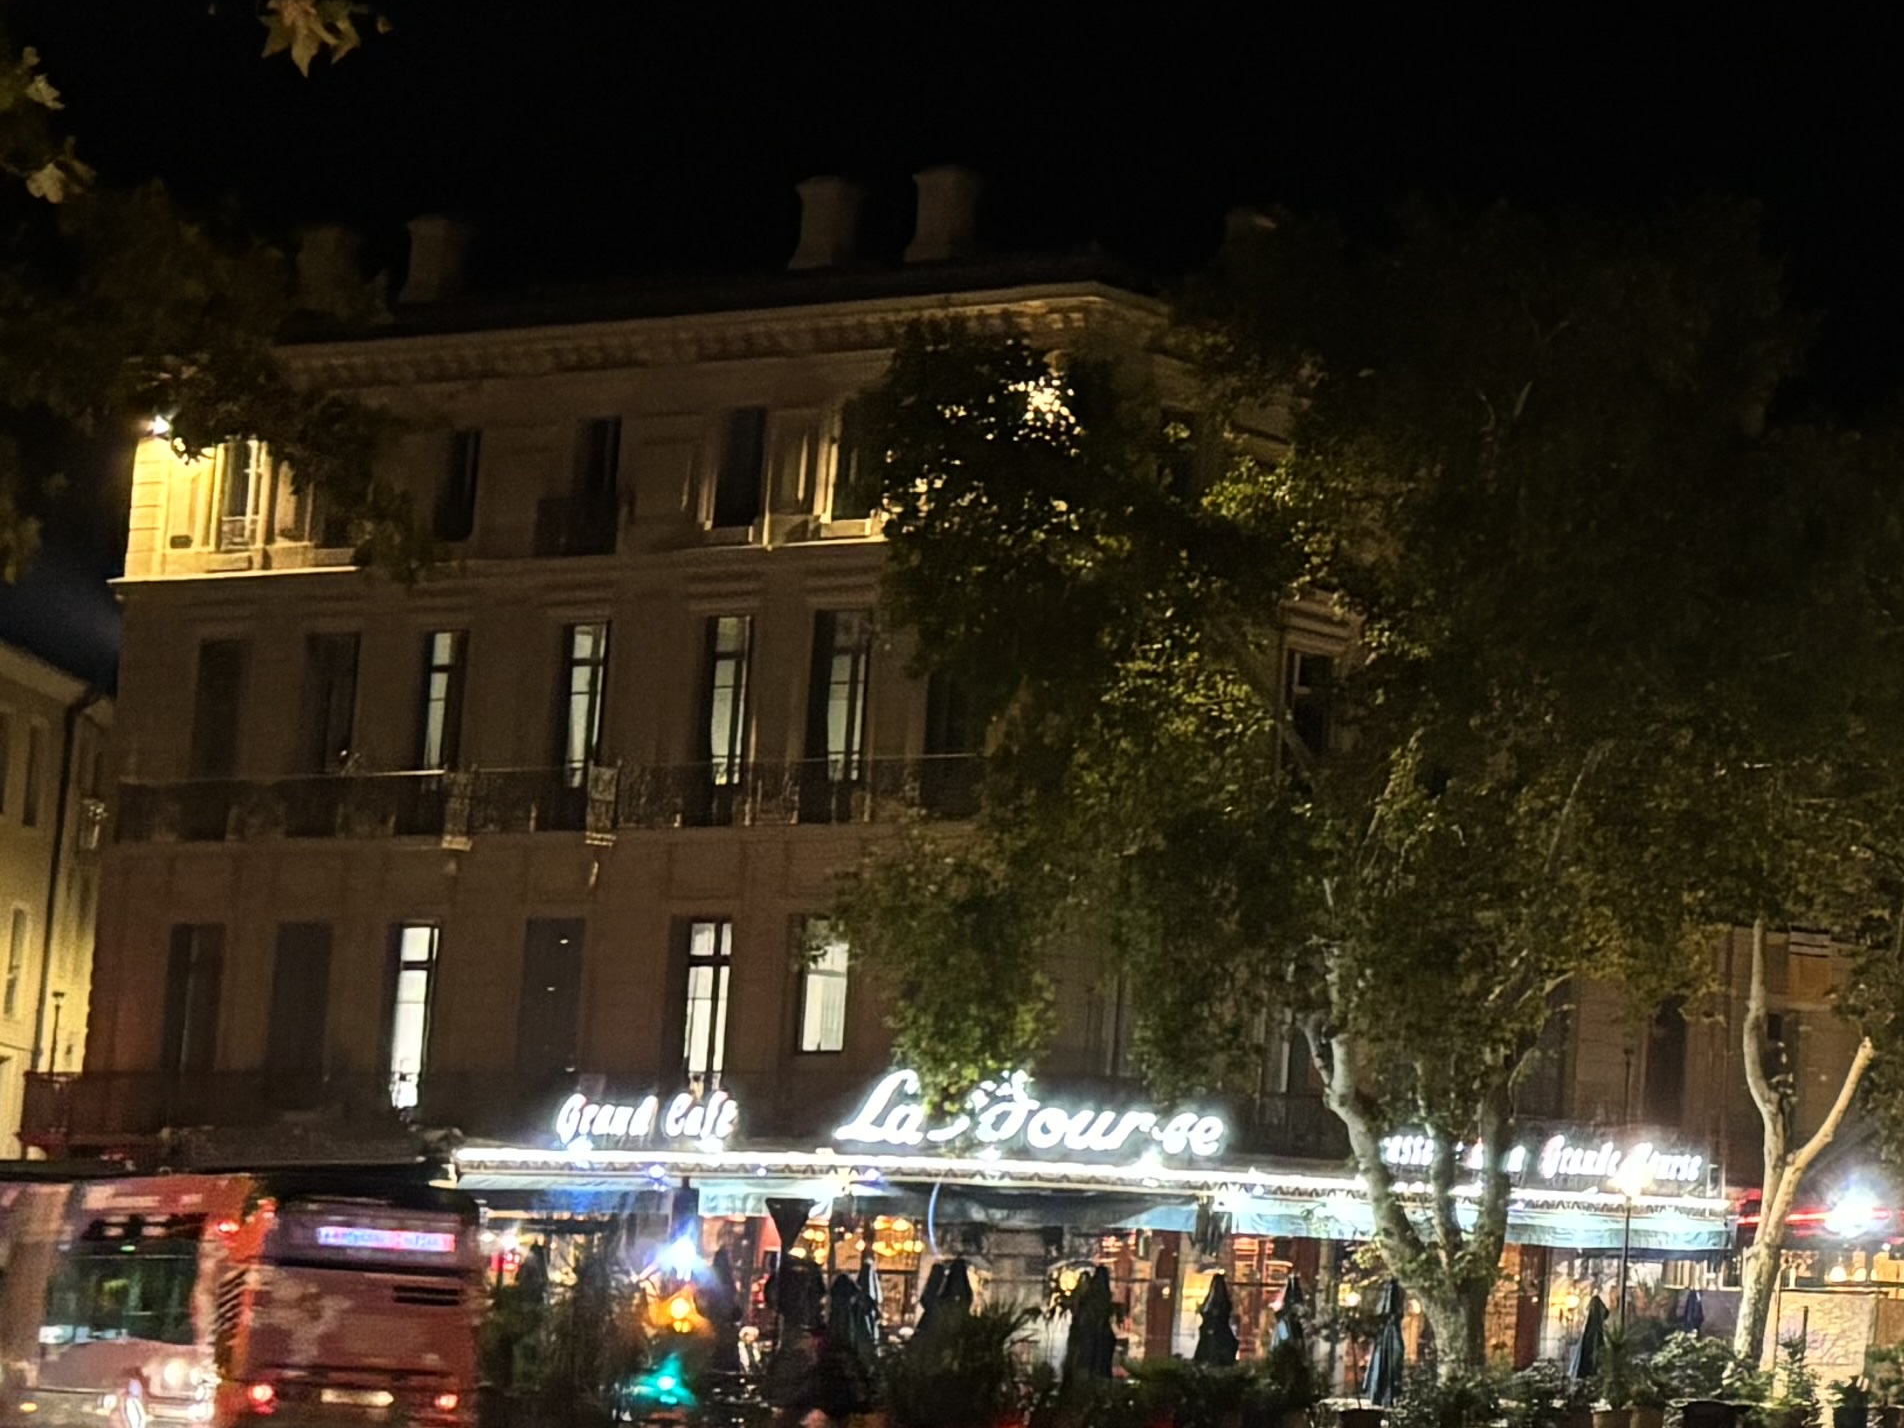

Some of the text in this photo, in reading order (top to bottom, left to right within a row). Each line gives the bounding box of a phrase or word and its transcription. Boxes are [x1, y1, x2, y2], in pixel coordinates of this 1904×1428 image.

[556, 1093, 659, 1145] Grand
[834, 1069, 925, 1145] La
[1540, 1135, 1622, 1179] Grande
